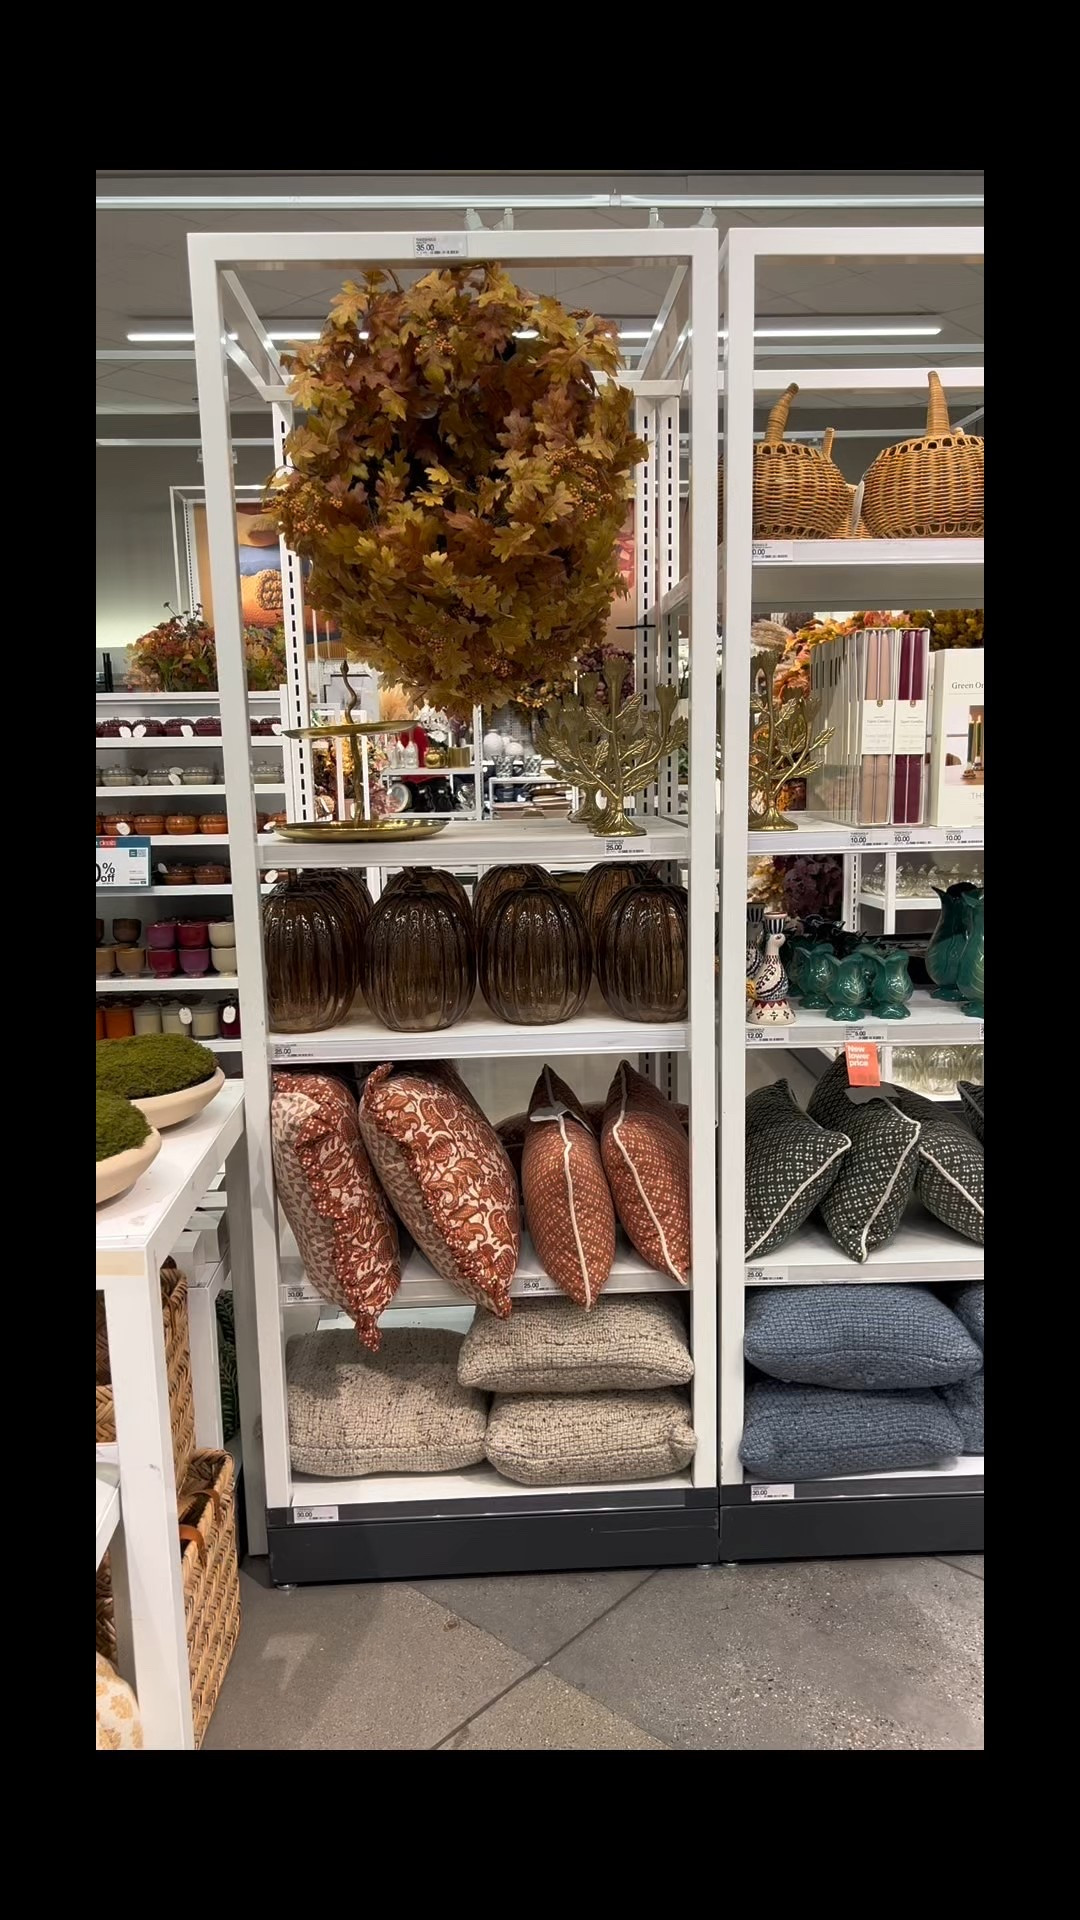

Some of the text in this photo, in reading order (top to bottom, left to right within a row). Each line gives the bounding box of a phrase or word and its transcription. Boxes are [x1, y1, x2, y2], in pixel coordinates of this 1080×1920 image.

[951, 681, 974, 690] Green
[100, 873, 115, 883] off
[848, 1045, 865, 1053] New
[849, 1060, 869, 1068] price
